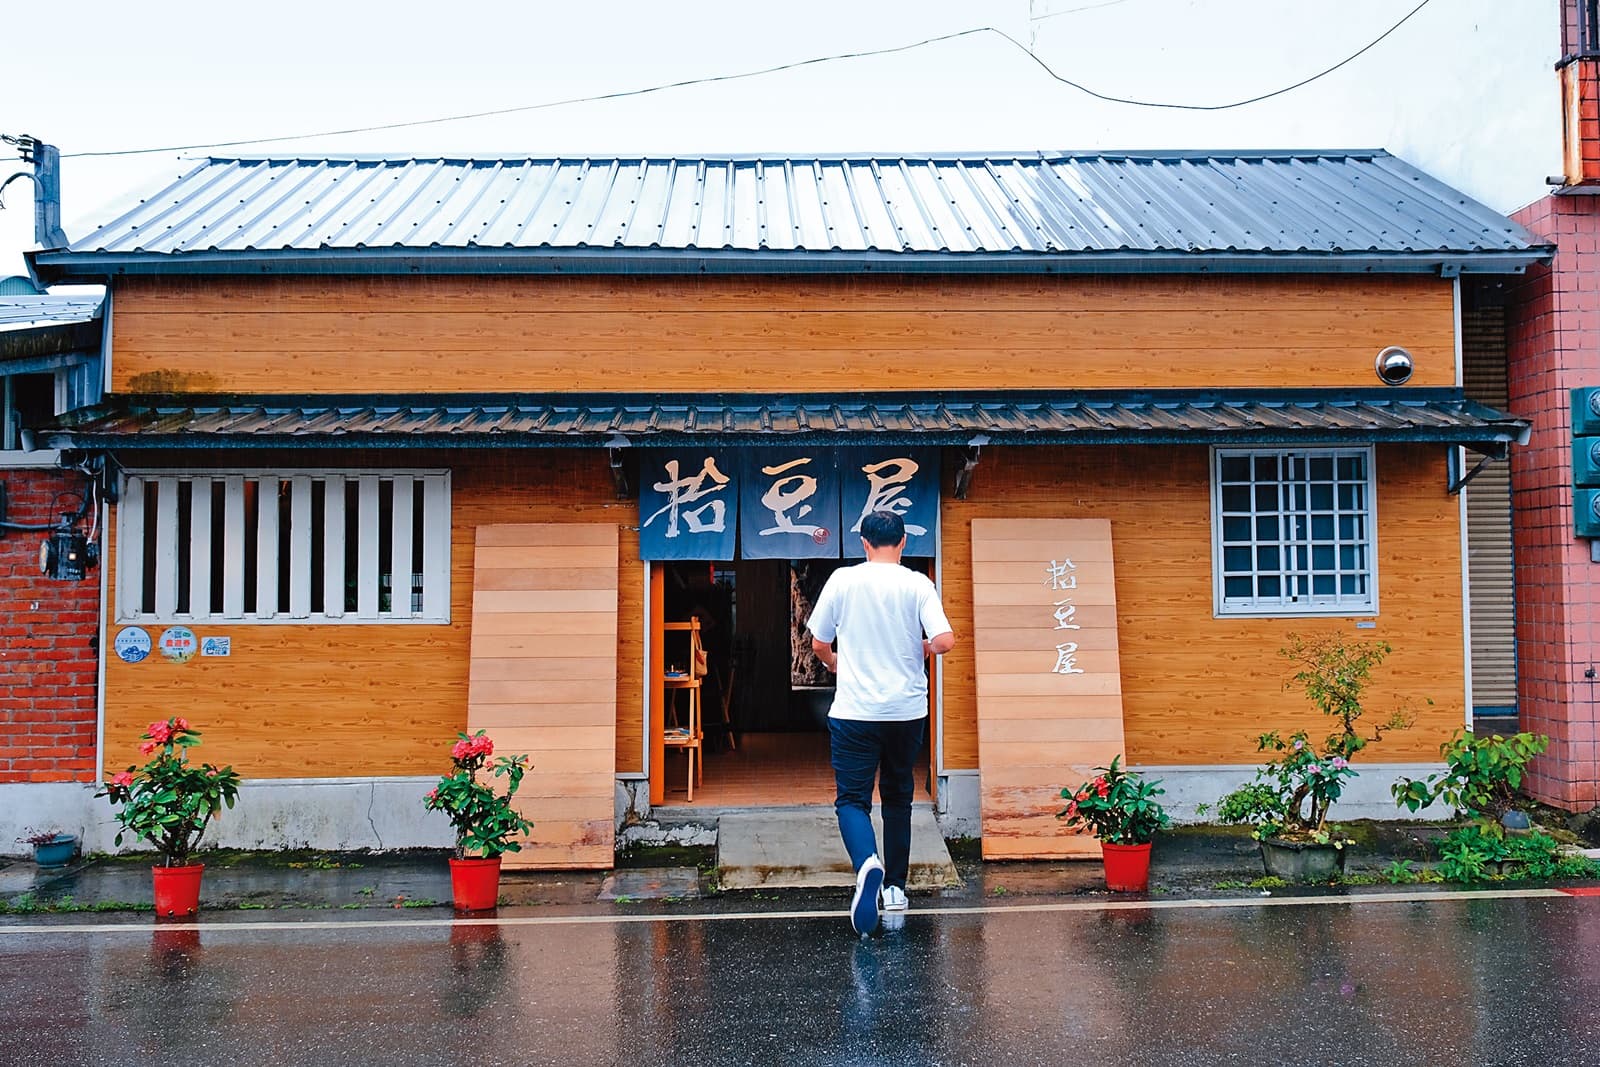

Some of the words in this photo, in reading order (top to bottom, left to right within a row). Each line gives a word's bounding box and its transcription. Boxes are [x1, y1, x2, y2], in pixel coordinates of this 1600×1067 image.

[643, 456, 928, 538] 拾豆屋
[1043, 558, 1084, 674] 拾豆屋
